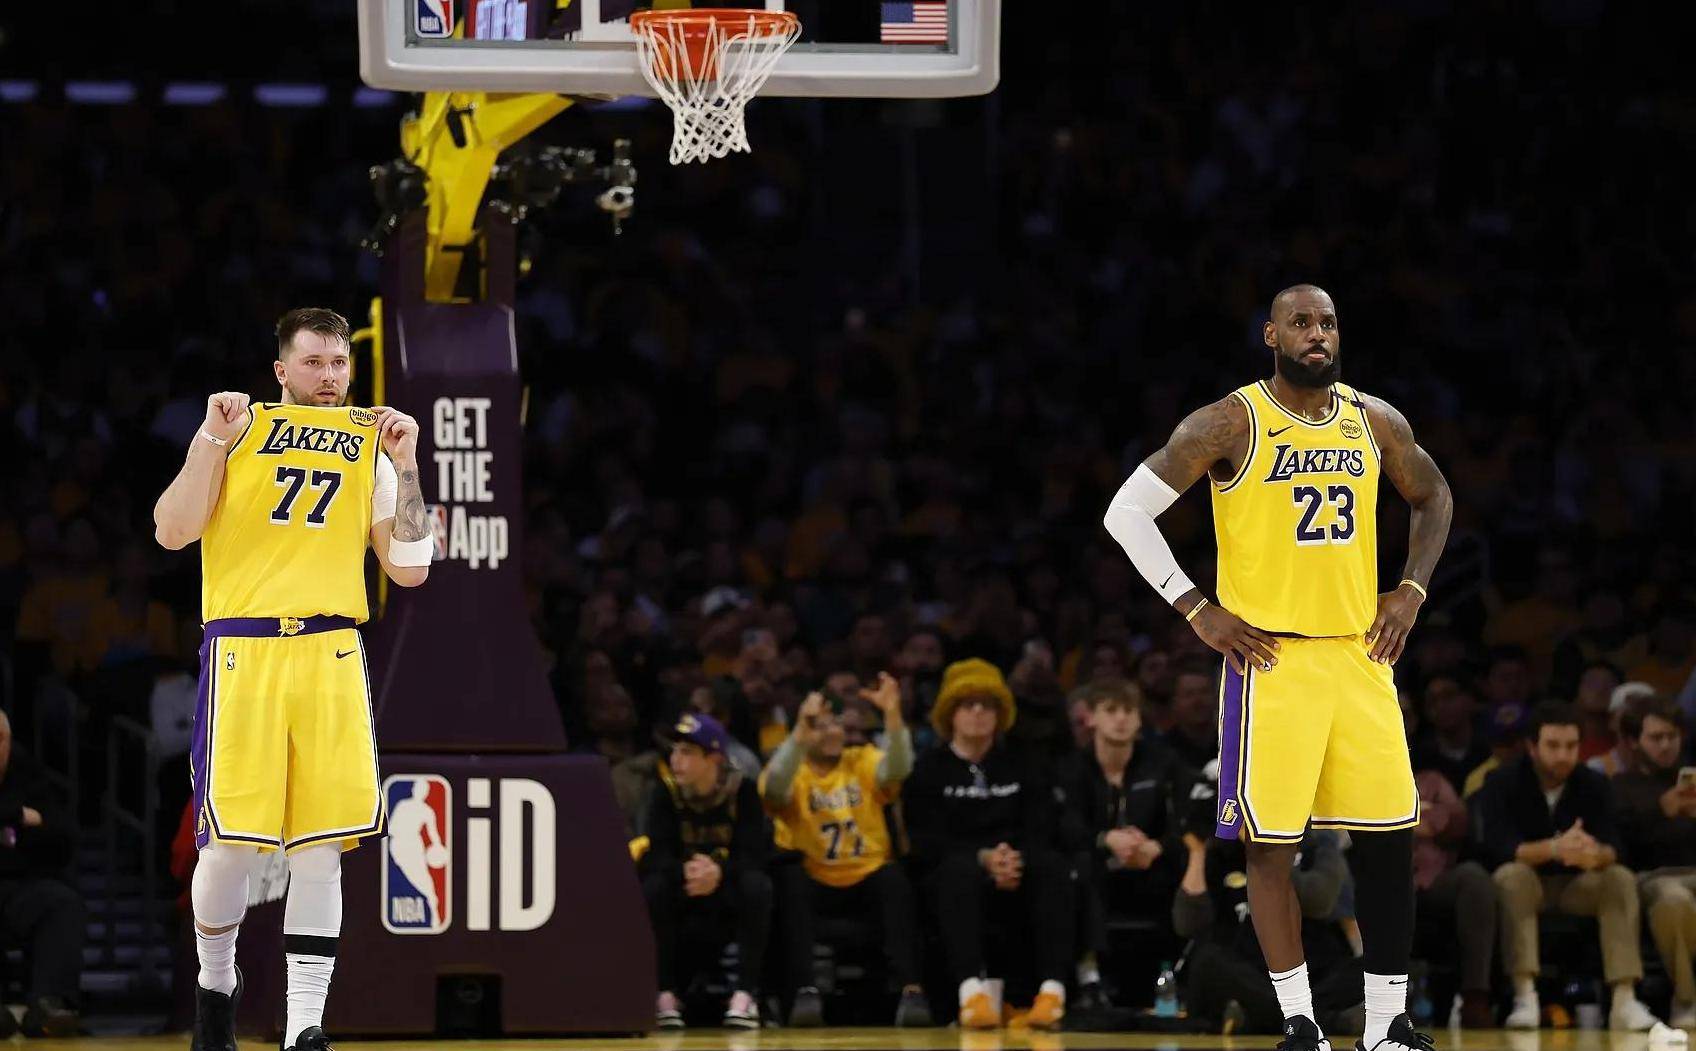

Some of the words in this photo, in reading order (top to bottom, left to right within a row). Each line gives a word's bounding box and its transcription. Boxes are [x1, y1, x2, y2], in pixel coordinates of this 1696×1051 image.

[257, 418, 364, 462] LAKERS
[433, 397, 492, 449] GET
[433, 451, 494, 502] THE
[1264, 444, 1365, 482] LAKERS
[269, 466, 342, 528] 77
[1293, 485, 1356, 546] 23
[448, 505, 509, 570] App
[466, 778, 557, 932] iD
[392, 896, 426, 923] NBA
